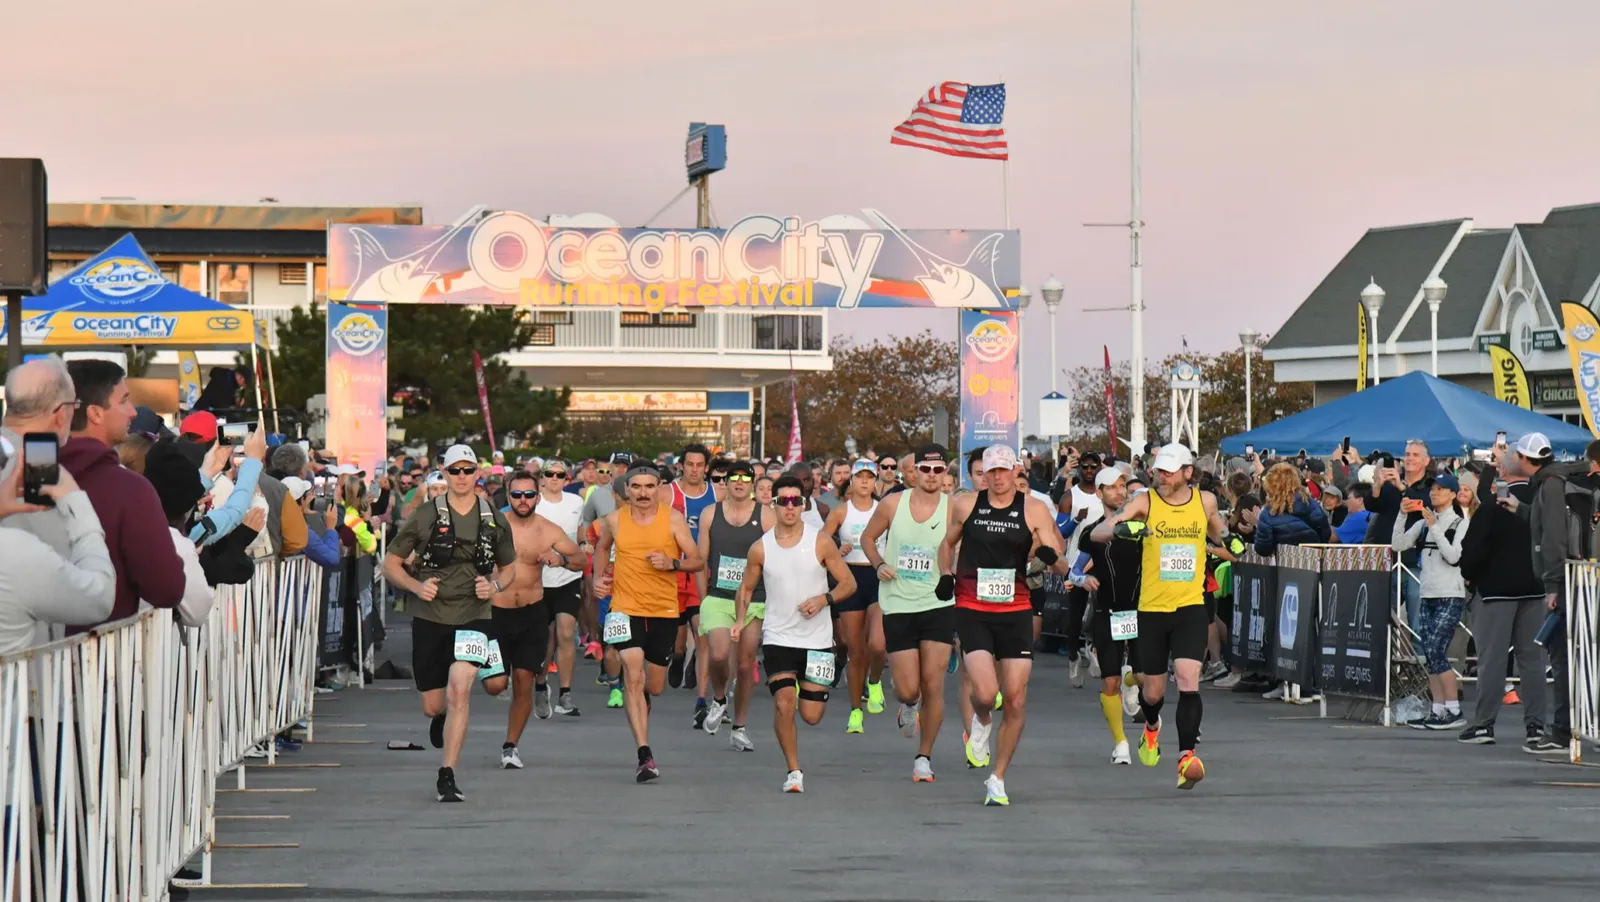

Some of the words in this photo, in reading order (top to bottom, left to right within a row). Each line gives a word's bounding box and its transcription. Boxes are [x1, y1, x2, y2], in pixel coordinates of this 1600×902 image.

[468, 211, 884, 310] OceanCity
[519, 274, 667, 313] Running
[678, 275, 814, 307] Festival
[73, 315, 177, 337] OceanCity
[334, 329, 381, 340] OceanCity
[968, 335, 1014, 345] OceanCity
[973, 519, 1020, 529] CINCINNATUS
[1155, 521, 1202, 538] Somerville
[907, 558, 930, 570] 3114
[1170, 558, 1193, 570] 3082
[988, 583, 1012, 596] 3330
[608, 623, 627, 637] 3385
[1121, 623, 1137, 634] 303
[465, 643, 486, 658] 3091
[811, 665, 833, 679] 3121
